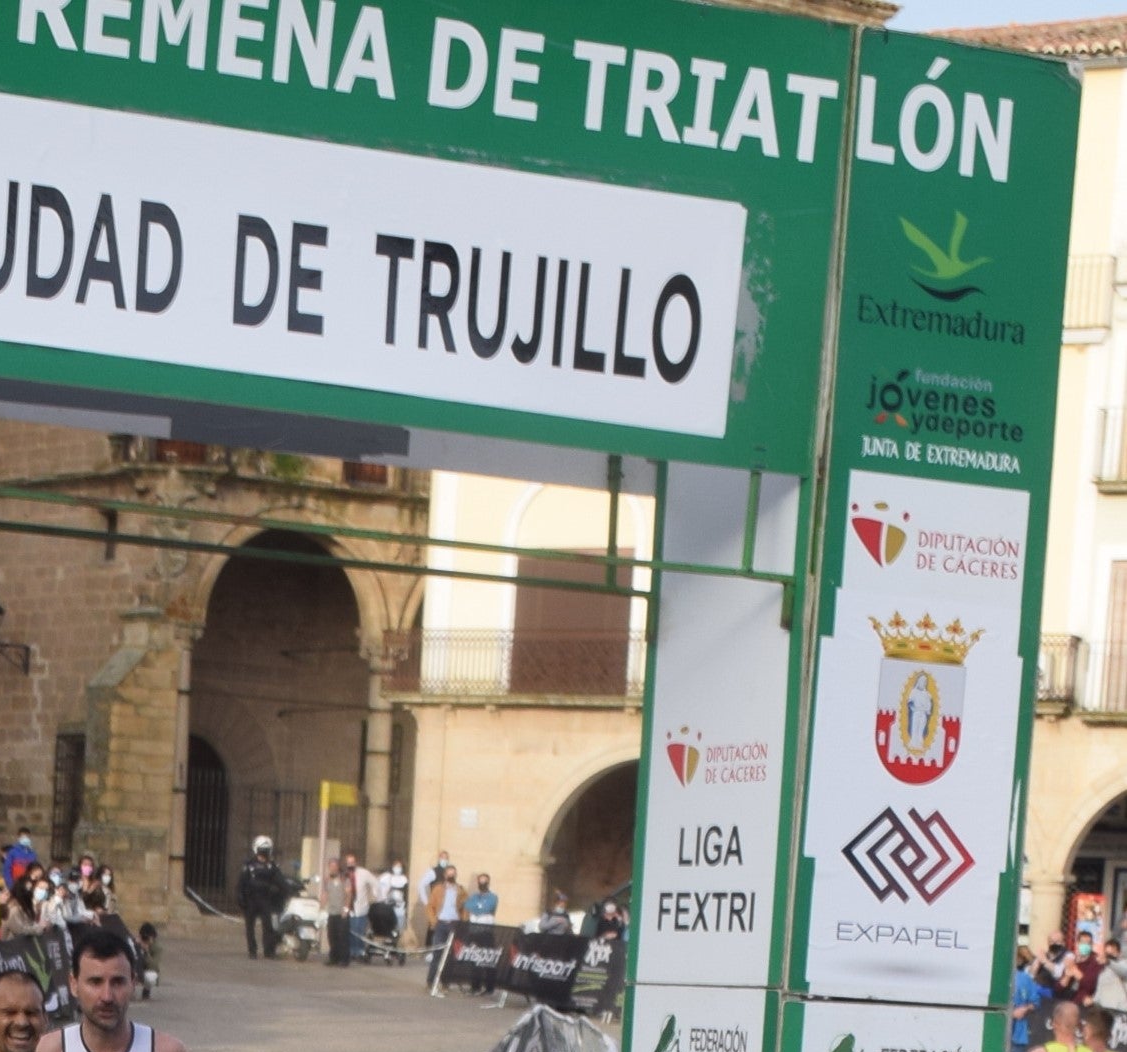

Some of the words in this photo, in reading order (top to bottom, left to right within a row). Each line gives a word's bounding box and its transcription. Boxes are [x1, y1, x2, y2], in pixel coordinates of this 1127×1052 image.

[427, 17, 546, 122] DE
[573, 40, 1014, 183] TRIATLÓN
[232, 213, 329, 336] DE
[374, 233, 702, 385] TRUJILLO
[858, 294, 1026, 346] Extremadura
[866, 369, 997, 419] jóvenes
[915, 368, 993, 393] fundación
[861, 434, 900, 460] JUNTA
[905, 441, 922, 462] DE
[927, 444, 1021, 474] EXTREMADURA
[917, 530, 1020, 559] DIPUTACIÓN
[916, 552, 936, 571] DE
[943, 553, 1018, 580] CÁCERES
[706, 742, 769, 763] DIPUTACIÓN
[705, 767, 718, 785] DE
[678, 825, 743, 868] LIGA
[657, 892, 756, 933] FEXTRI
[836, 921, 969, 951] EXPAPEL
